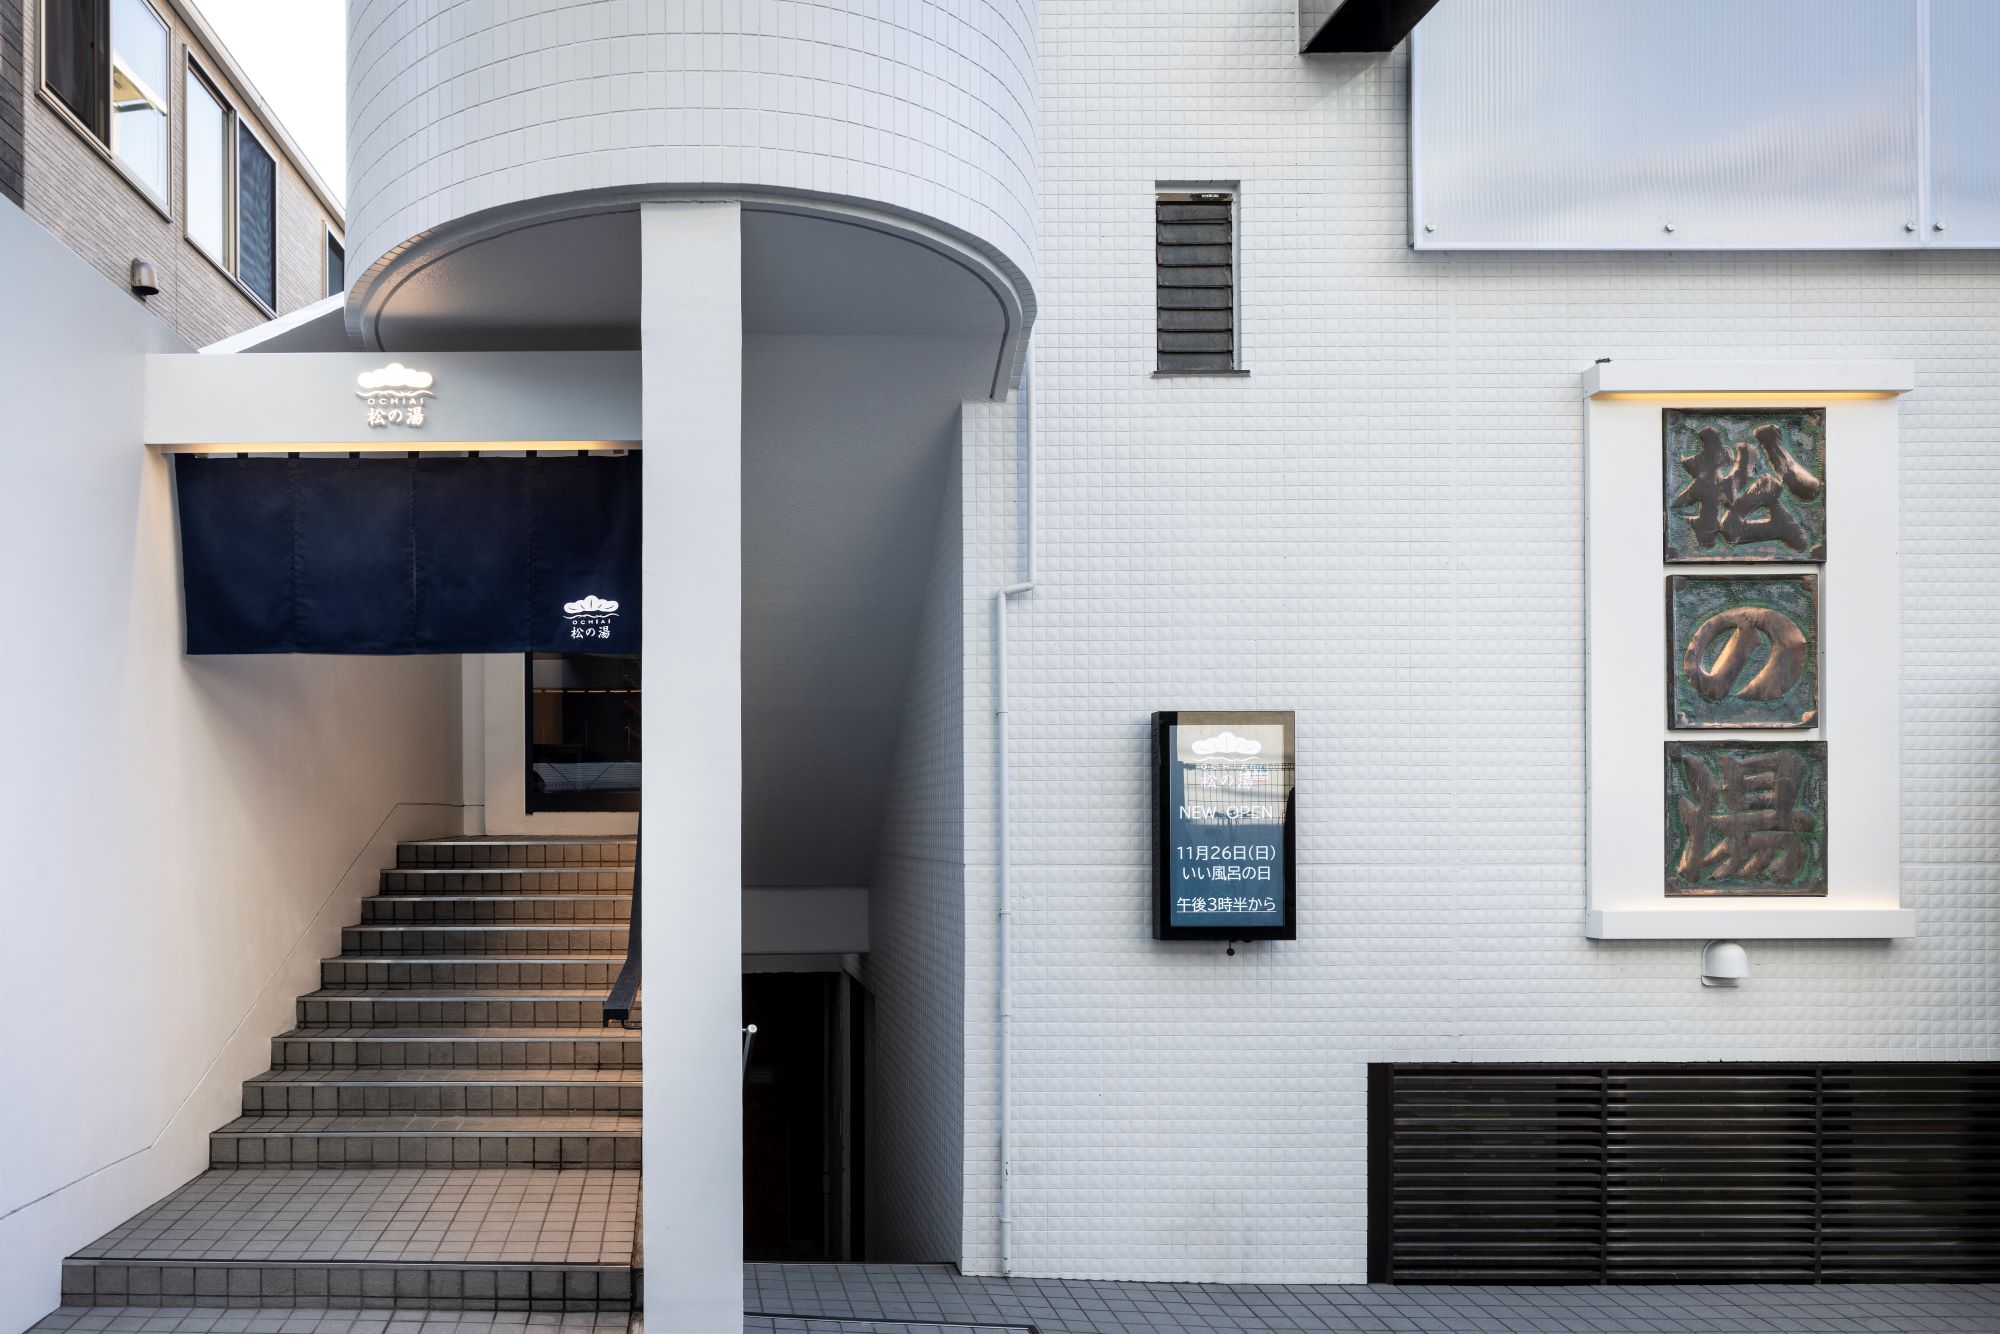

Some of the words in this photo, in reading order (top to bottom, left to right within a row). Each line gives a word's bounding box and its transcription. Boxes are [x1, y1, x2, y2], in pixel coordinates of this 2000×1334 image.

[367, 397, 424, 405] OCHIAI
[367, 406, 424, 426] 松の湯
[570, 625, 611, 640] 松の湯
[1671, 423, 1820, 885] 松の湯
[1200, 771, 1253, 789] 松の湯
[1179, 805, 1217, 819] NEW
[1226, 805, 1273, 819] OPEN
[1176, 845, 1276, 861] 11月26日(日)
[1182, 865, 1271, 881] いい風呂の日
[1176, 896, 1277, 912] 午後3時半から
